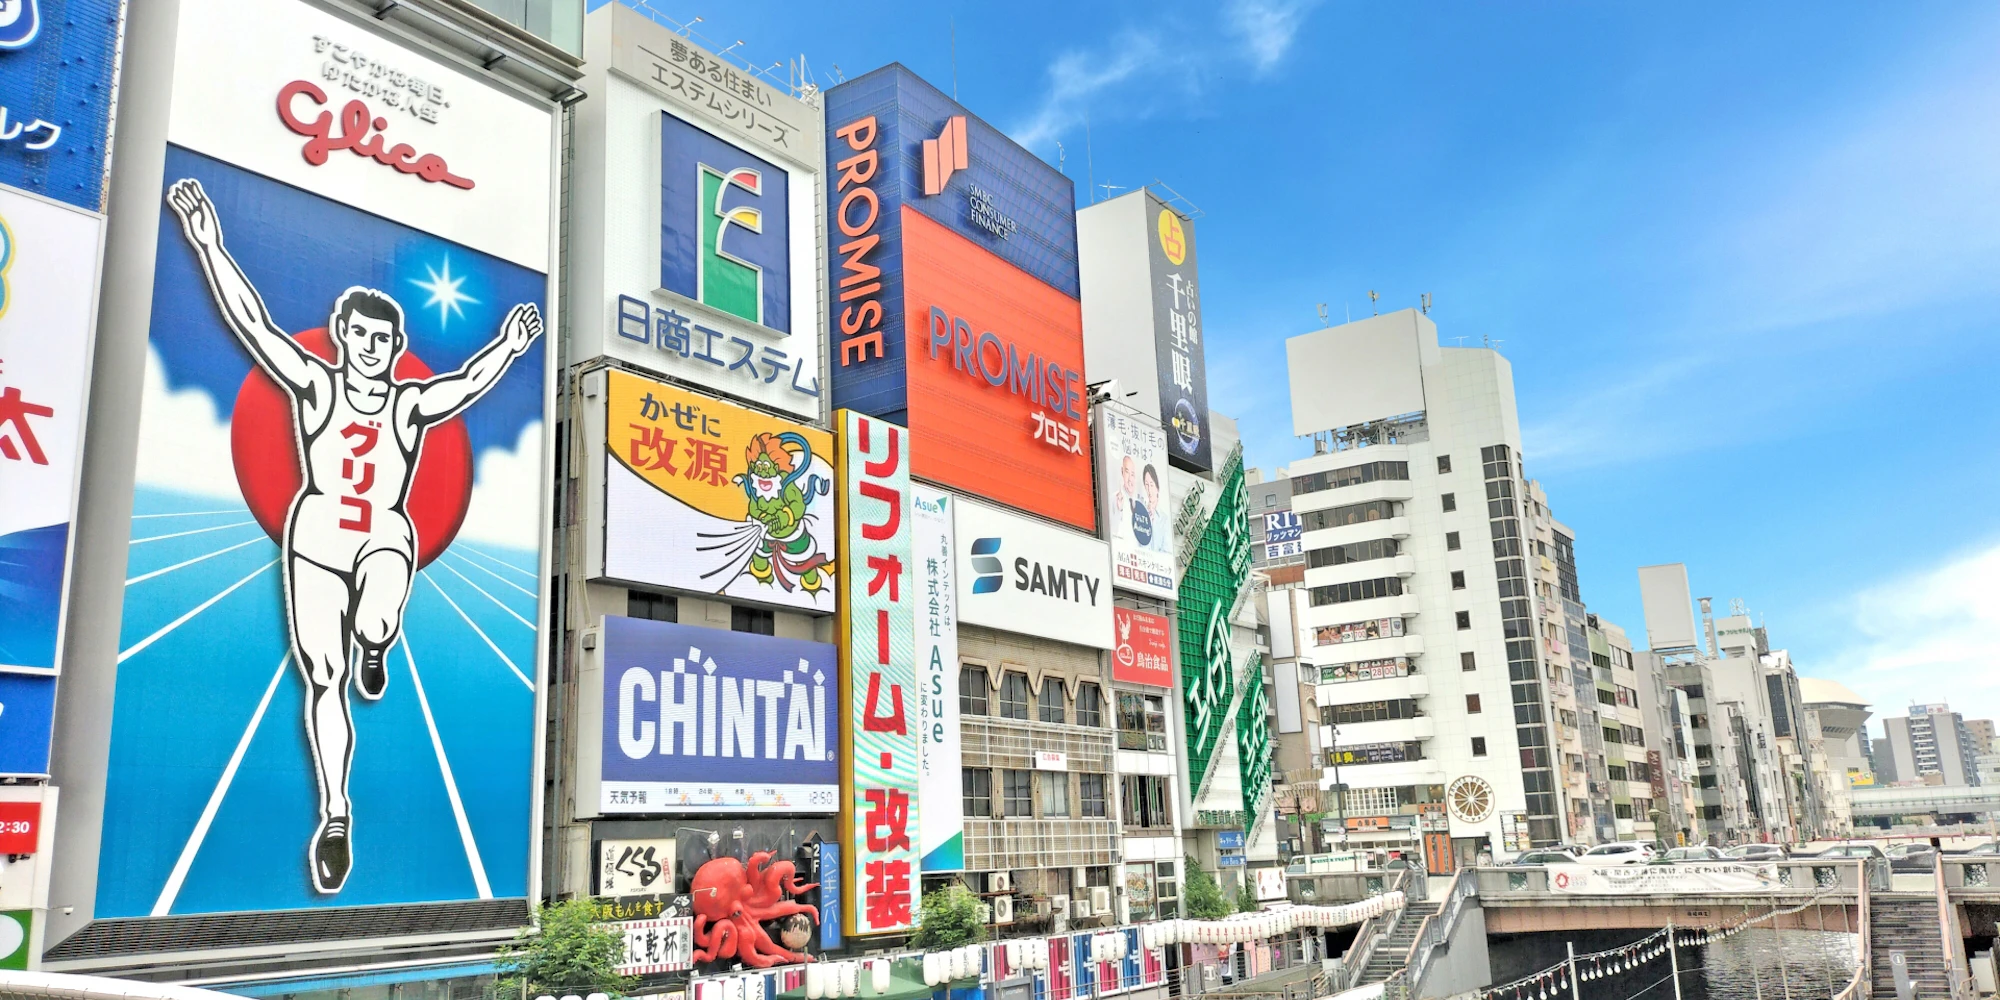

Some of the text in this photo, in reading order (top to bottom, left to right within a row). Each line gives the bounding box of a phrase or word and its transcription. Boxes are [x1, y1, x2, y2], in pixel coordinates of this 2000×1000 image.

[322, 61, 438, 125] ゆたかな人生
[651, 62, 788, 148] エステムシリーズ
[670, 38, 772, 107] 夢ある住まい
[277, 80, 475, 190] Glico
[969, 183, 994, 206] SMBC
[969, 196, 1017, 234] CONSUMER
[970, 209, 1009, 241] FINANCE
[835, 116, 884, 367] PROMISE
[1164, 212, 1182, 260] 占
[618, 293, 819, 398] 日商エステム
[929, 305, 1081, 421] PROMISE
[1166, 272, 1193, 395] 千里眼
[640, 392, 721, 438] かぜに
[1030, 411, 1084, 456] プロミス
[1107, 412, 1165, 450] 薄毛・抜け毛の
[339, 420, 382, 533] グリコ
[629, 422, 729, 487] 改源
[915, 496, 938, 513] Asue
[1014, 556, 1100, 607] SAMTY
[1117, 552, 1130, 564] AGA
[858, 418, 912, 930] リフォーム・改装
[927, 557, 944, 743] 株式会社 Asue
[1188, 597, 1232, 756] エイブル
[618, 646, 826, 762] CHINTAI
[920, 682, 930, 777] に変わりました。
[610, 790, 647, 805] 天気予報
[615, 846, 661, 887] くくる
[824, 850, 837, 938] ペンギンバー
